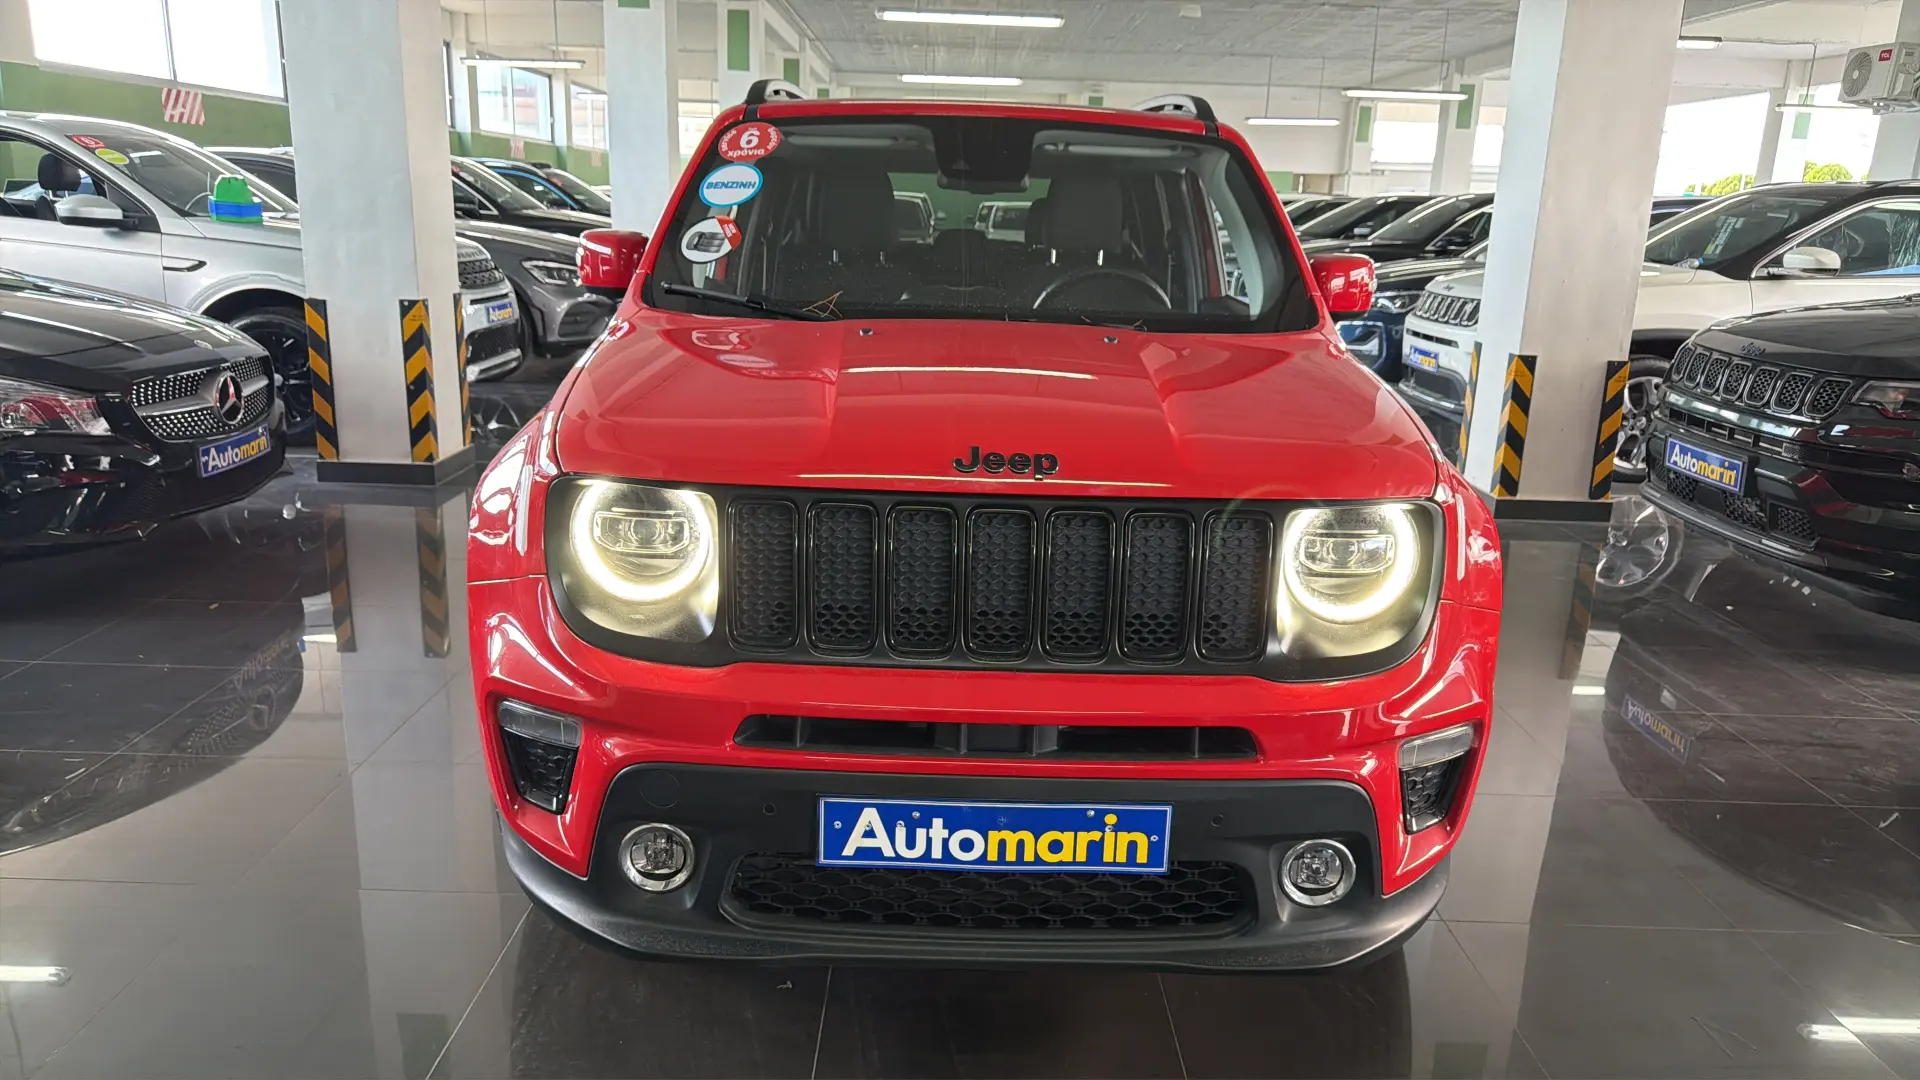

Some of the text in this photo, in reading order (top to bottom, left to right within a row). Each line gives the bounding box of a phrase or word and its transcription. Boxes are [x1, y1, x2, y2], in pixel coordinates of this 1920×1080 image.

[727, 148, 765, 158] χρόνια
[739, 129, 761, 149] 6
[207, 430, 268, 472] Automarin
[953, 445, 1059, 481] Jeep
[1670, 444, 1737, 486] Automarin
[841, 807, 1149, 864] Automarin
